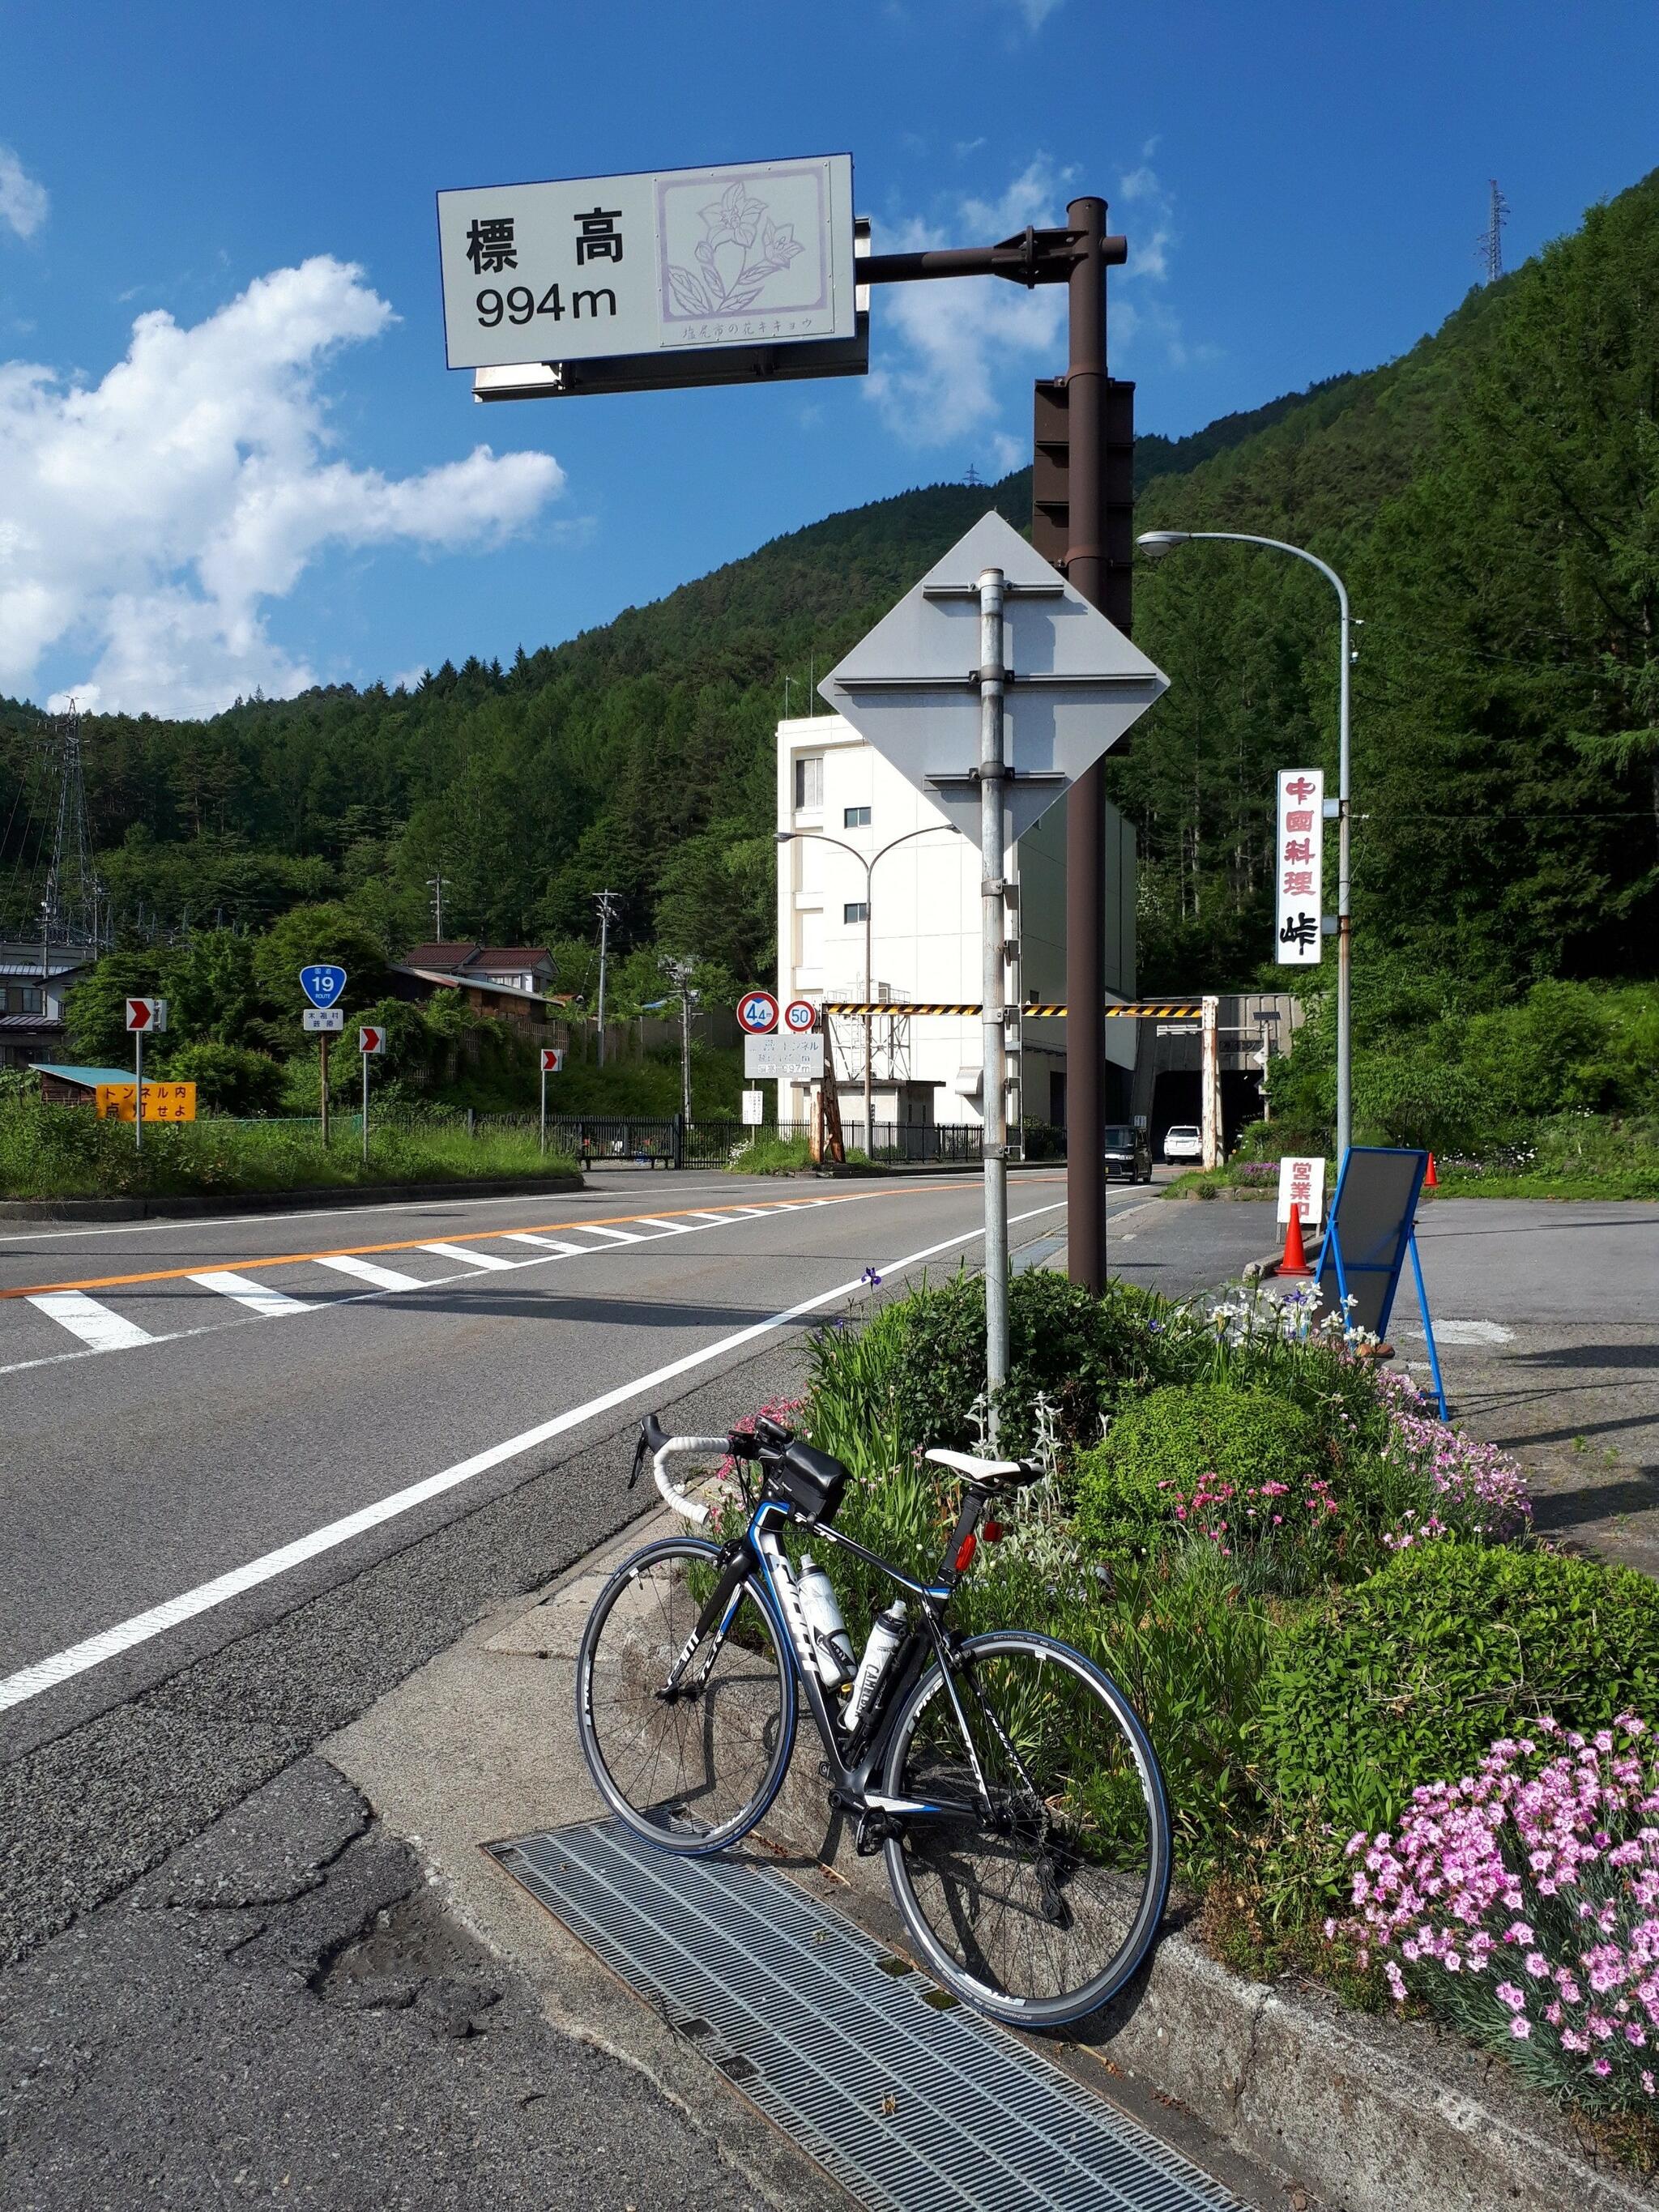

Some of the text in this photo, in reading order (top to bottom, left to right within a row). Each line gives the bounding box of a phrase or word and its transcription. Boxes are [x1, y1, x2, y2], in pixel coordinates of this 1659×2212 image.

[466, 207, 624, 275] 標高
[476, 283, 616, 327] 994m
[683, 318, 812, 339] 塩尻市の花キキョウ
[1280, 912, 1319, 956] 峠
[312, 976, 334, 992] 19
[791, 1009, 808, 1023] 50
[105, 1086, 186, 1099] トンネル内
